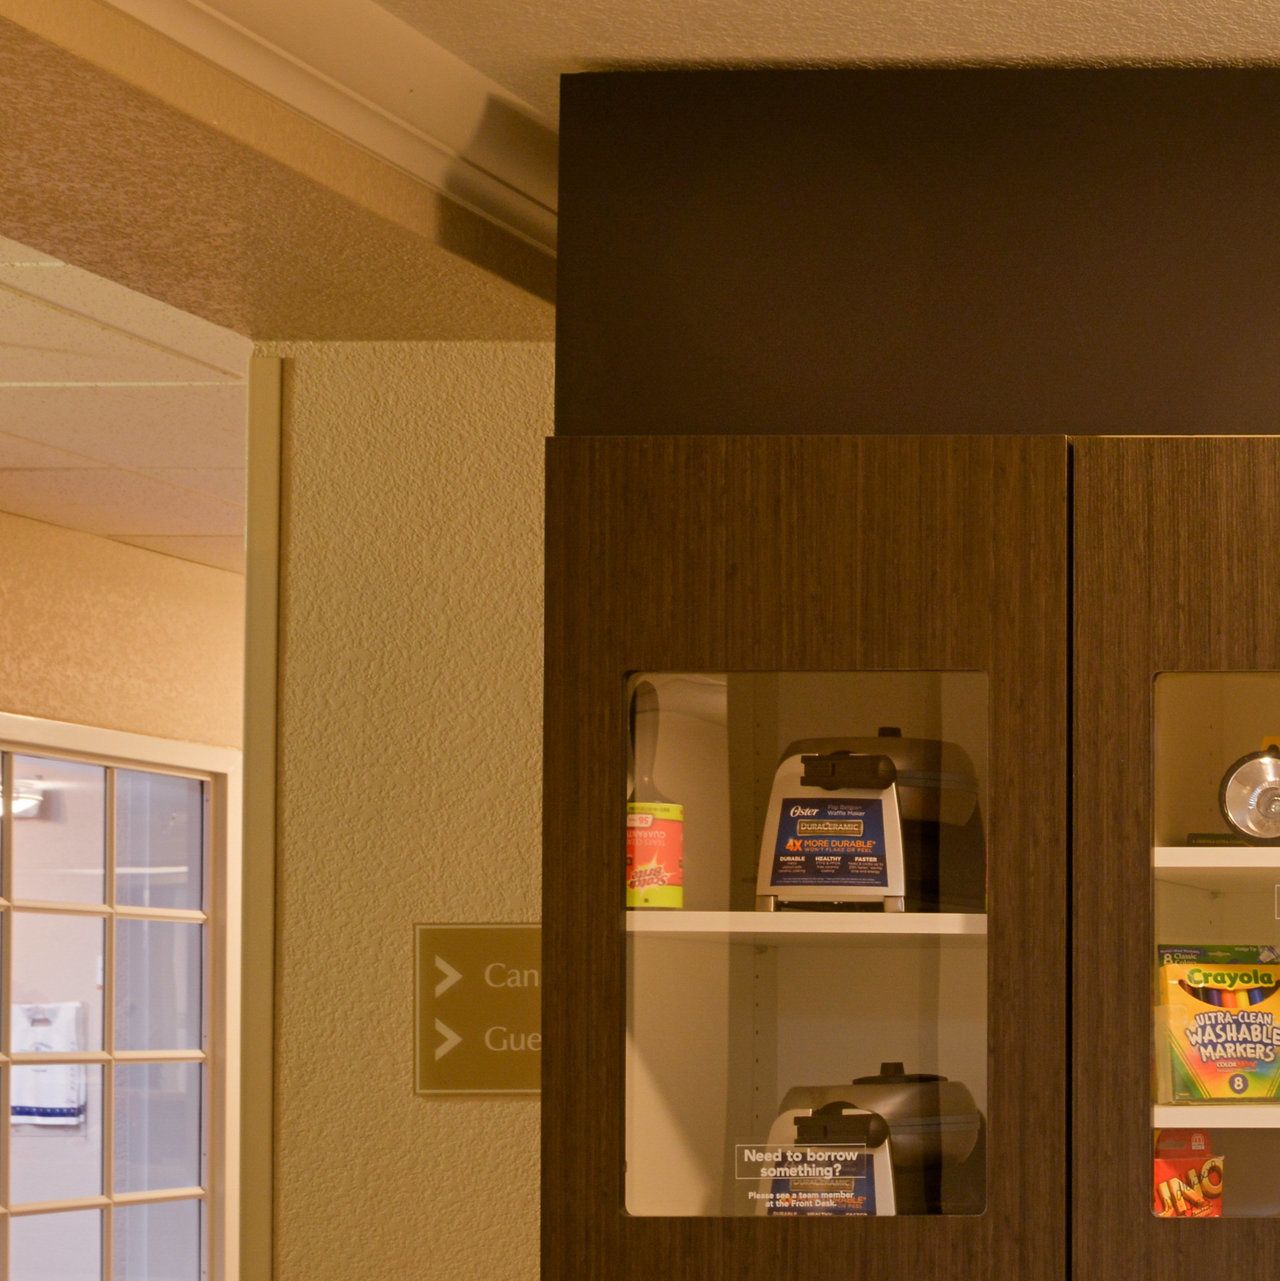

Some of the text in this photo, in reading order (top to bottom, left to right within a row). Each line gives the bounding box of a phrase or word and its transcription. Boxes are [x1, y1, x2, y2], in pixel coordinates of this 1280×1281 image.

[790, 805, 819, 817] Oster
[785, 838, 803, 851] 4X
[1188, 969, 1272, 987] Crayola
[1196, 1012, 1272, 1026] ULTRA-CLEAN
[1201, 1044, 1276, 1061] MARKERS
[1234, 1077, 1243, 1089] 8
[744, 1149, 858, 1161] Need to borrow
[761, 1164, 841, 1179] something?
